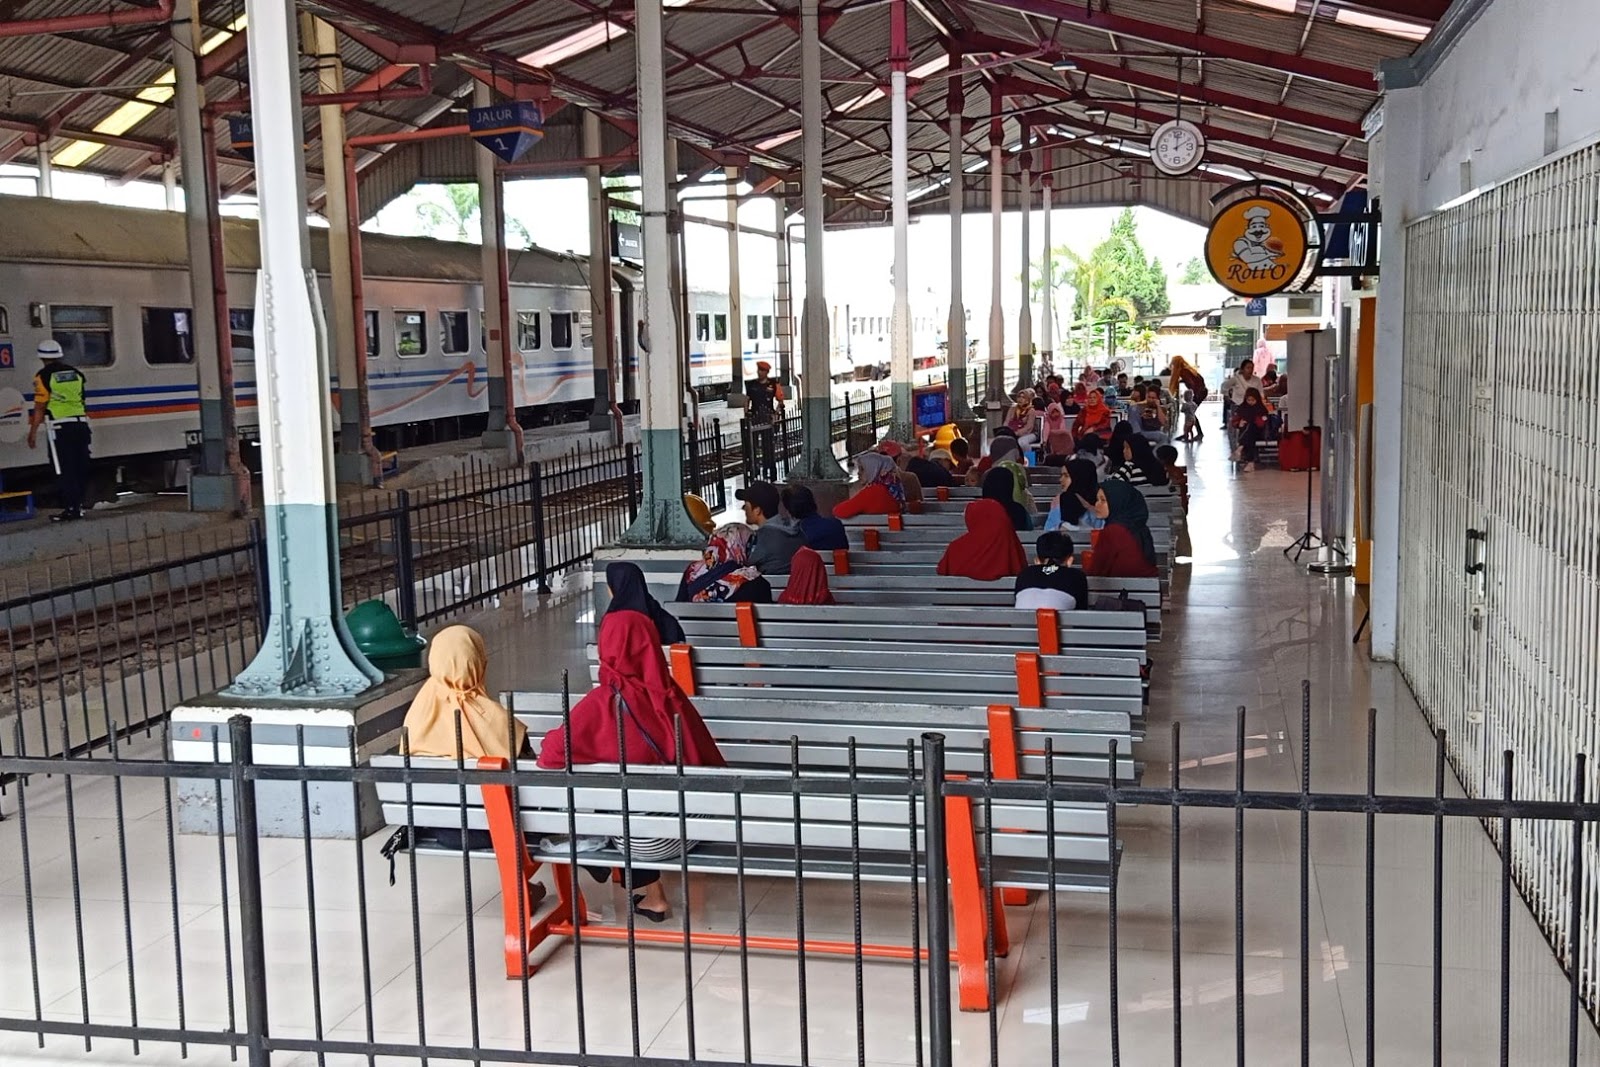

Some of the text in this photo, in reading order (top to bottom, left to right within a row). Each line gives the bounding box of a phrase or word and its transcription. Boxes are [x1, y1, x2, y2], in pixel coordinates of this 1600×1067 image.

[476, 109, 513, 124] JALUR
[237, 123, 251, 135] JA
[1172, 130, 1183, 139] 12
[494, 137, 509, 151] 1
[1160, 144, 1168, 153] 9
[1186, 142, 1194, 151] 3
[1173, 156, 1181, 165] 6
[0, 347, 11, 366] 6
